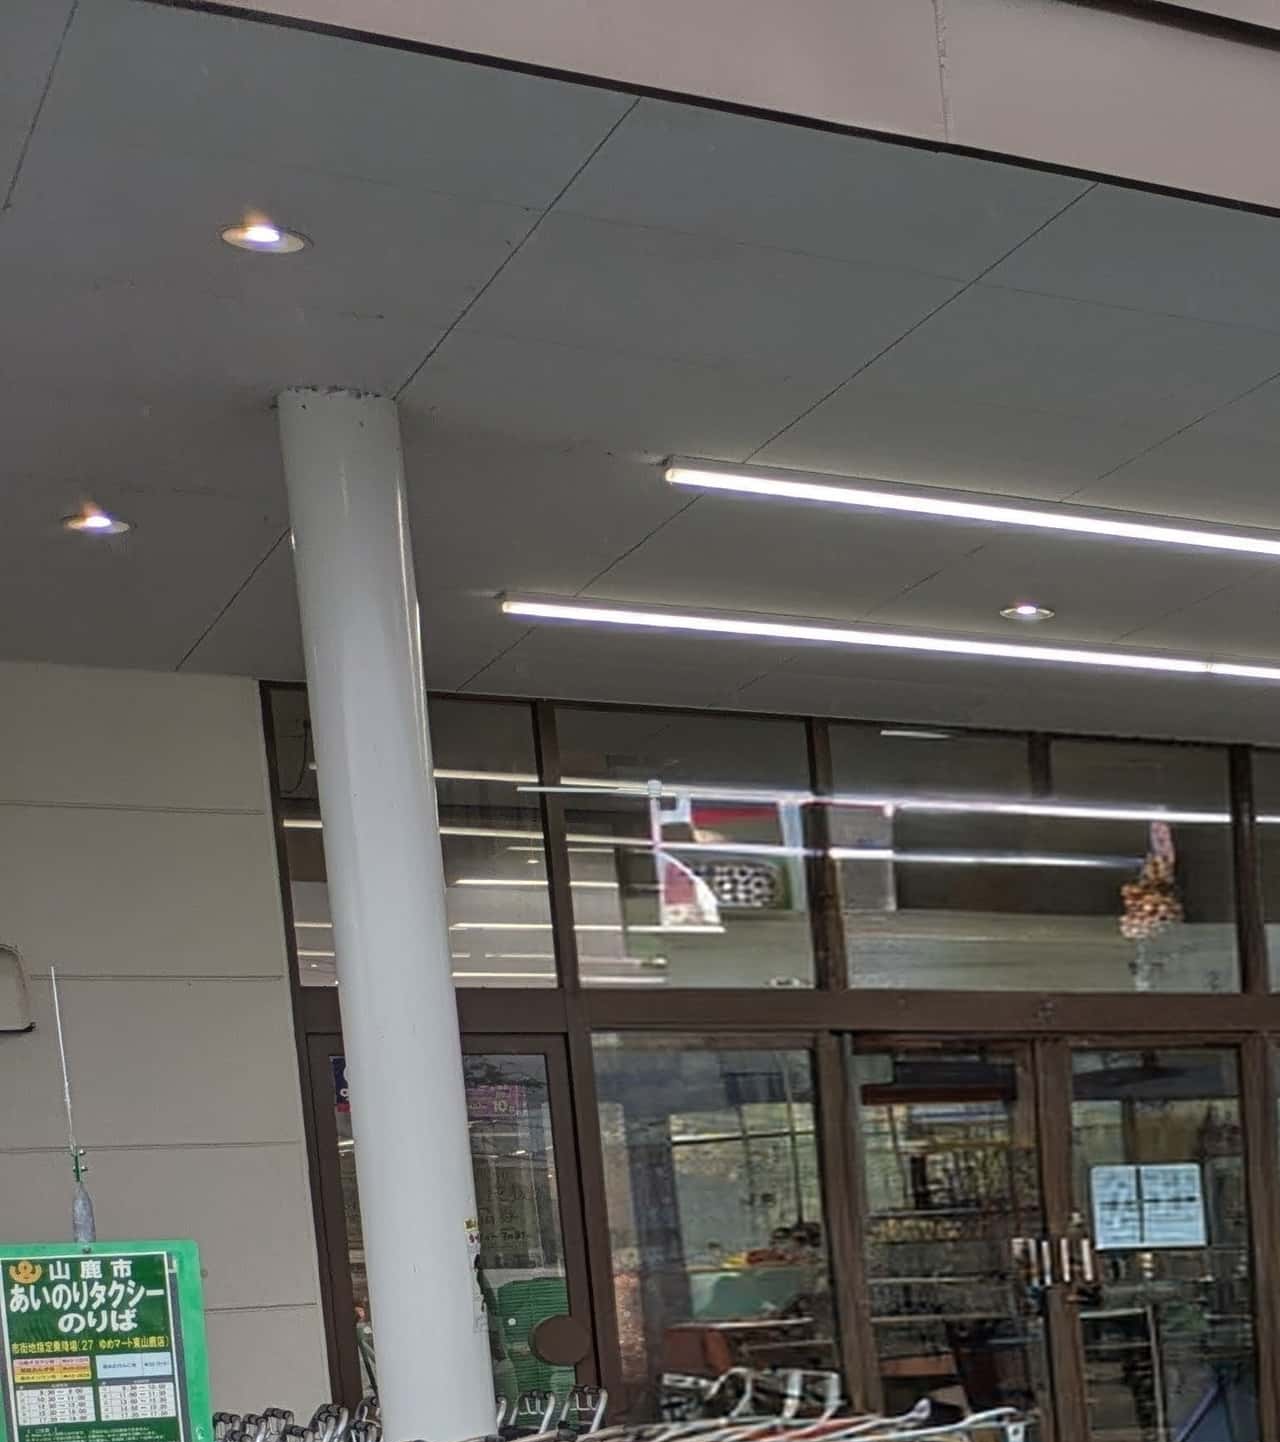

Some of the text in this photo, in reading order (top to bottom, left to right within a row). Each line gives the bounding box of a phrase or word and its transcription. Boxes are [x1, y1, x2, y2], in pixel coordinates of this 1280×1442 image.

[9, 1280, 164, 1313] あいのりタクシー
[57, 1308, 138, 1333] のりば
